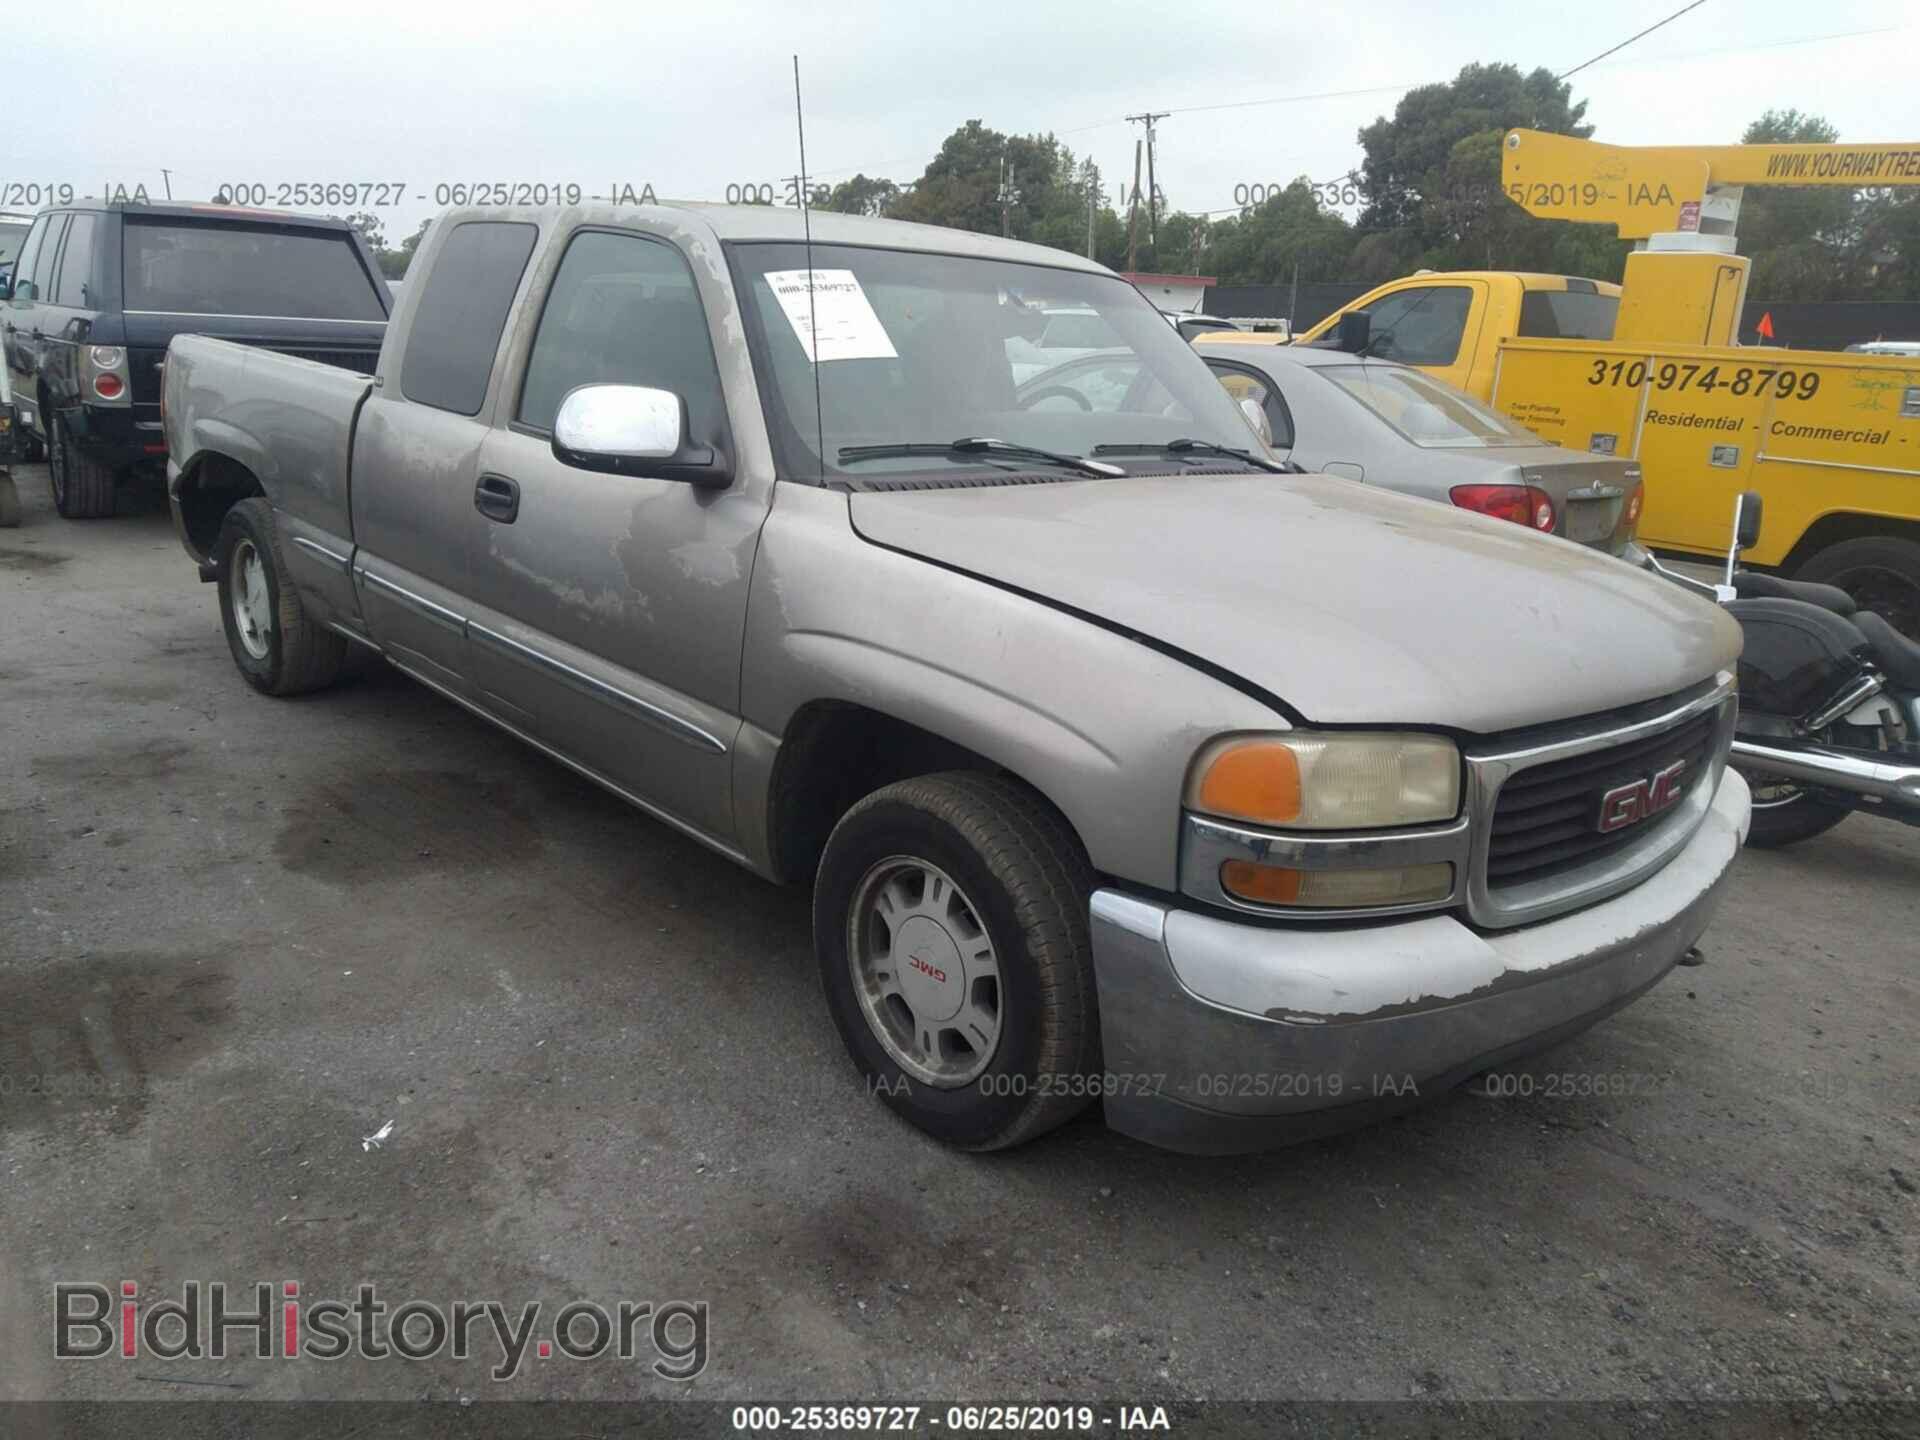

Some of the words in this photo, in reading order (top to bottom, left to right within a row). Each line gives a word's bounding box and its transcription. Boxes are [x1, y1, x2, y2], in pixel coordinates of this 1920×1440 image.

[1766, 151, 1920, 177] WWW.YOURWAYTRE
[1588, 359, 1820, 401] 310-974-8799
[1645, 410, 1743, 432] Residential
[1771, 420, 1890, 445] Commercial
[1598, 760, 1685, 833] GMC
[909, 955, 946, 983] GMC
